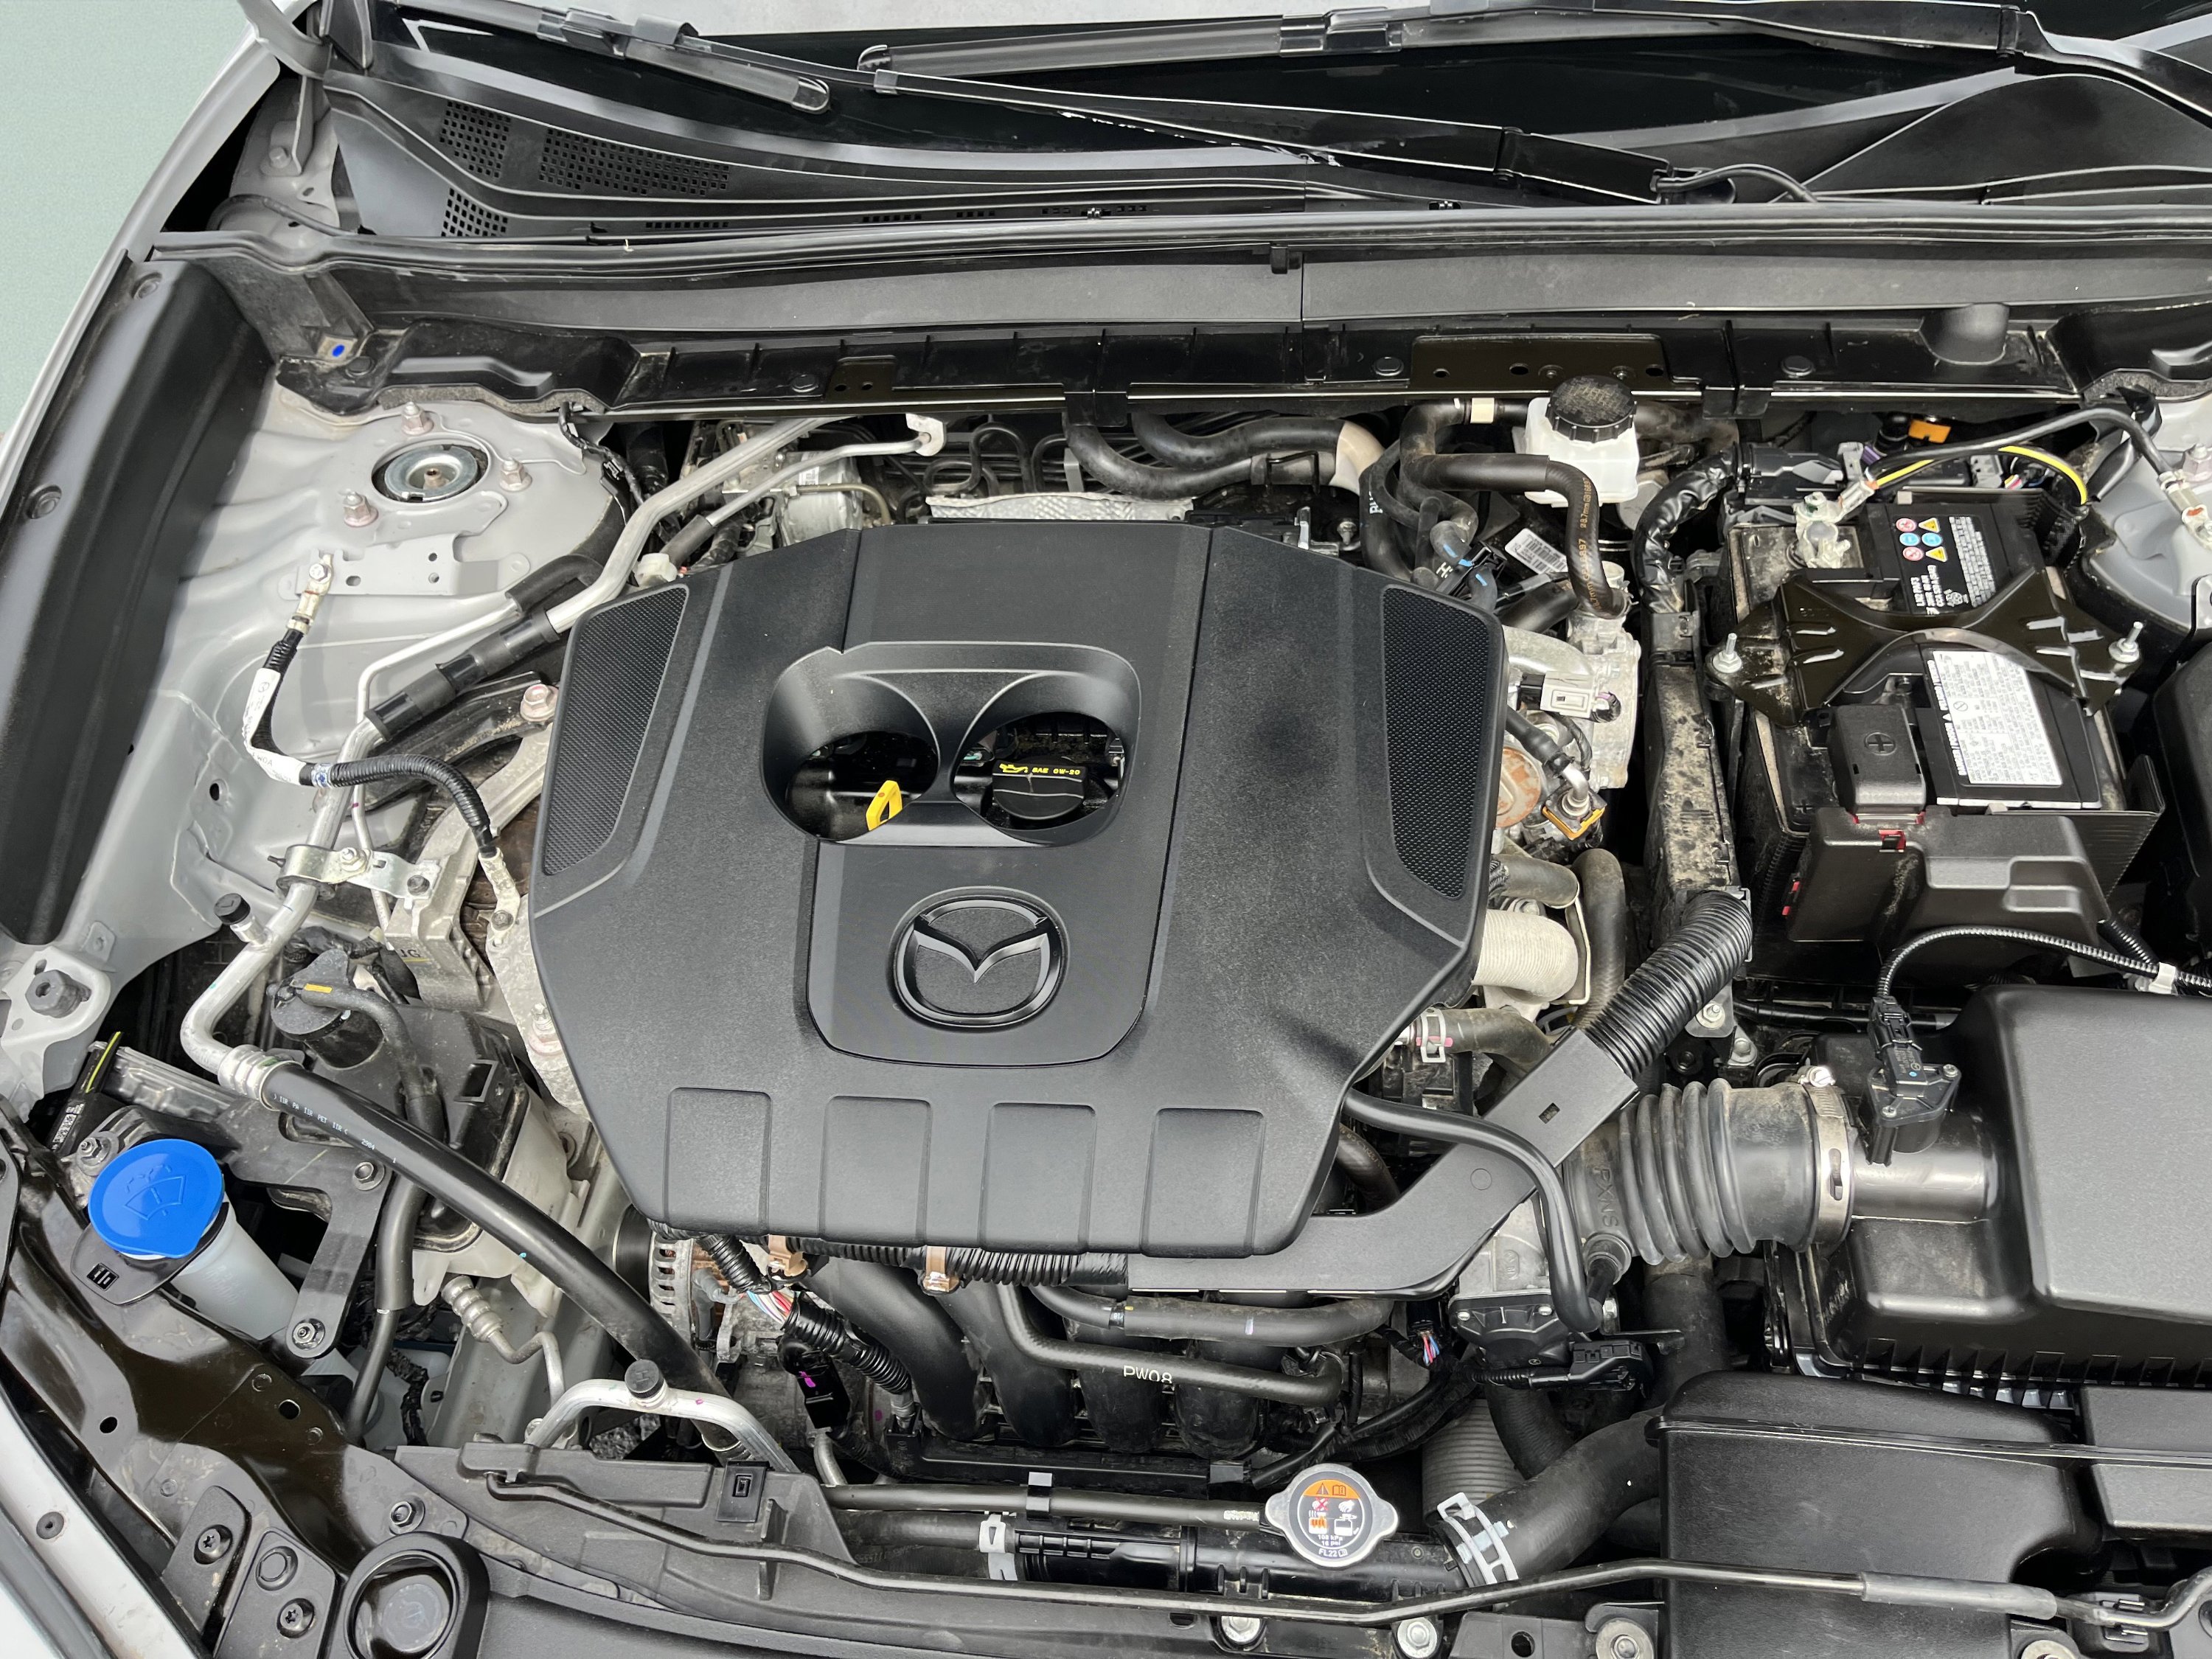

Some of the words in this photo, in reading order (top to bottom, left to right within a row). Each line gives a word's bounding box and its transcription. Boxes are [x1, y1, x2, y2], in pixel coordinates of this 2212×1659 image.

[292, 1102, 299, 1110] PA
[317, 1114, 328, 1124] PET
[1593, 1167, 1619, 1226] PXNS
[1123, 1365, 1172, 1384] PW08
[1319, 1548, 1338, 1557] FL22
